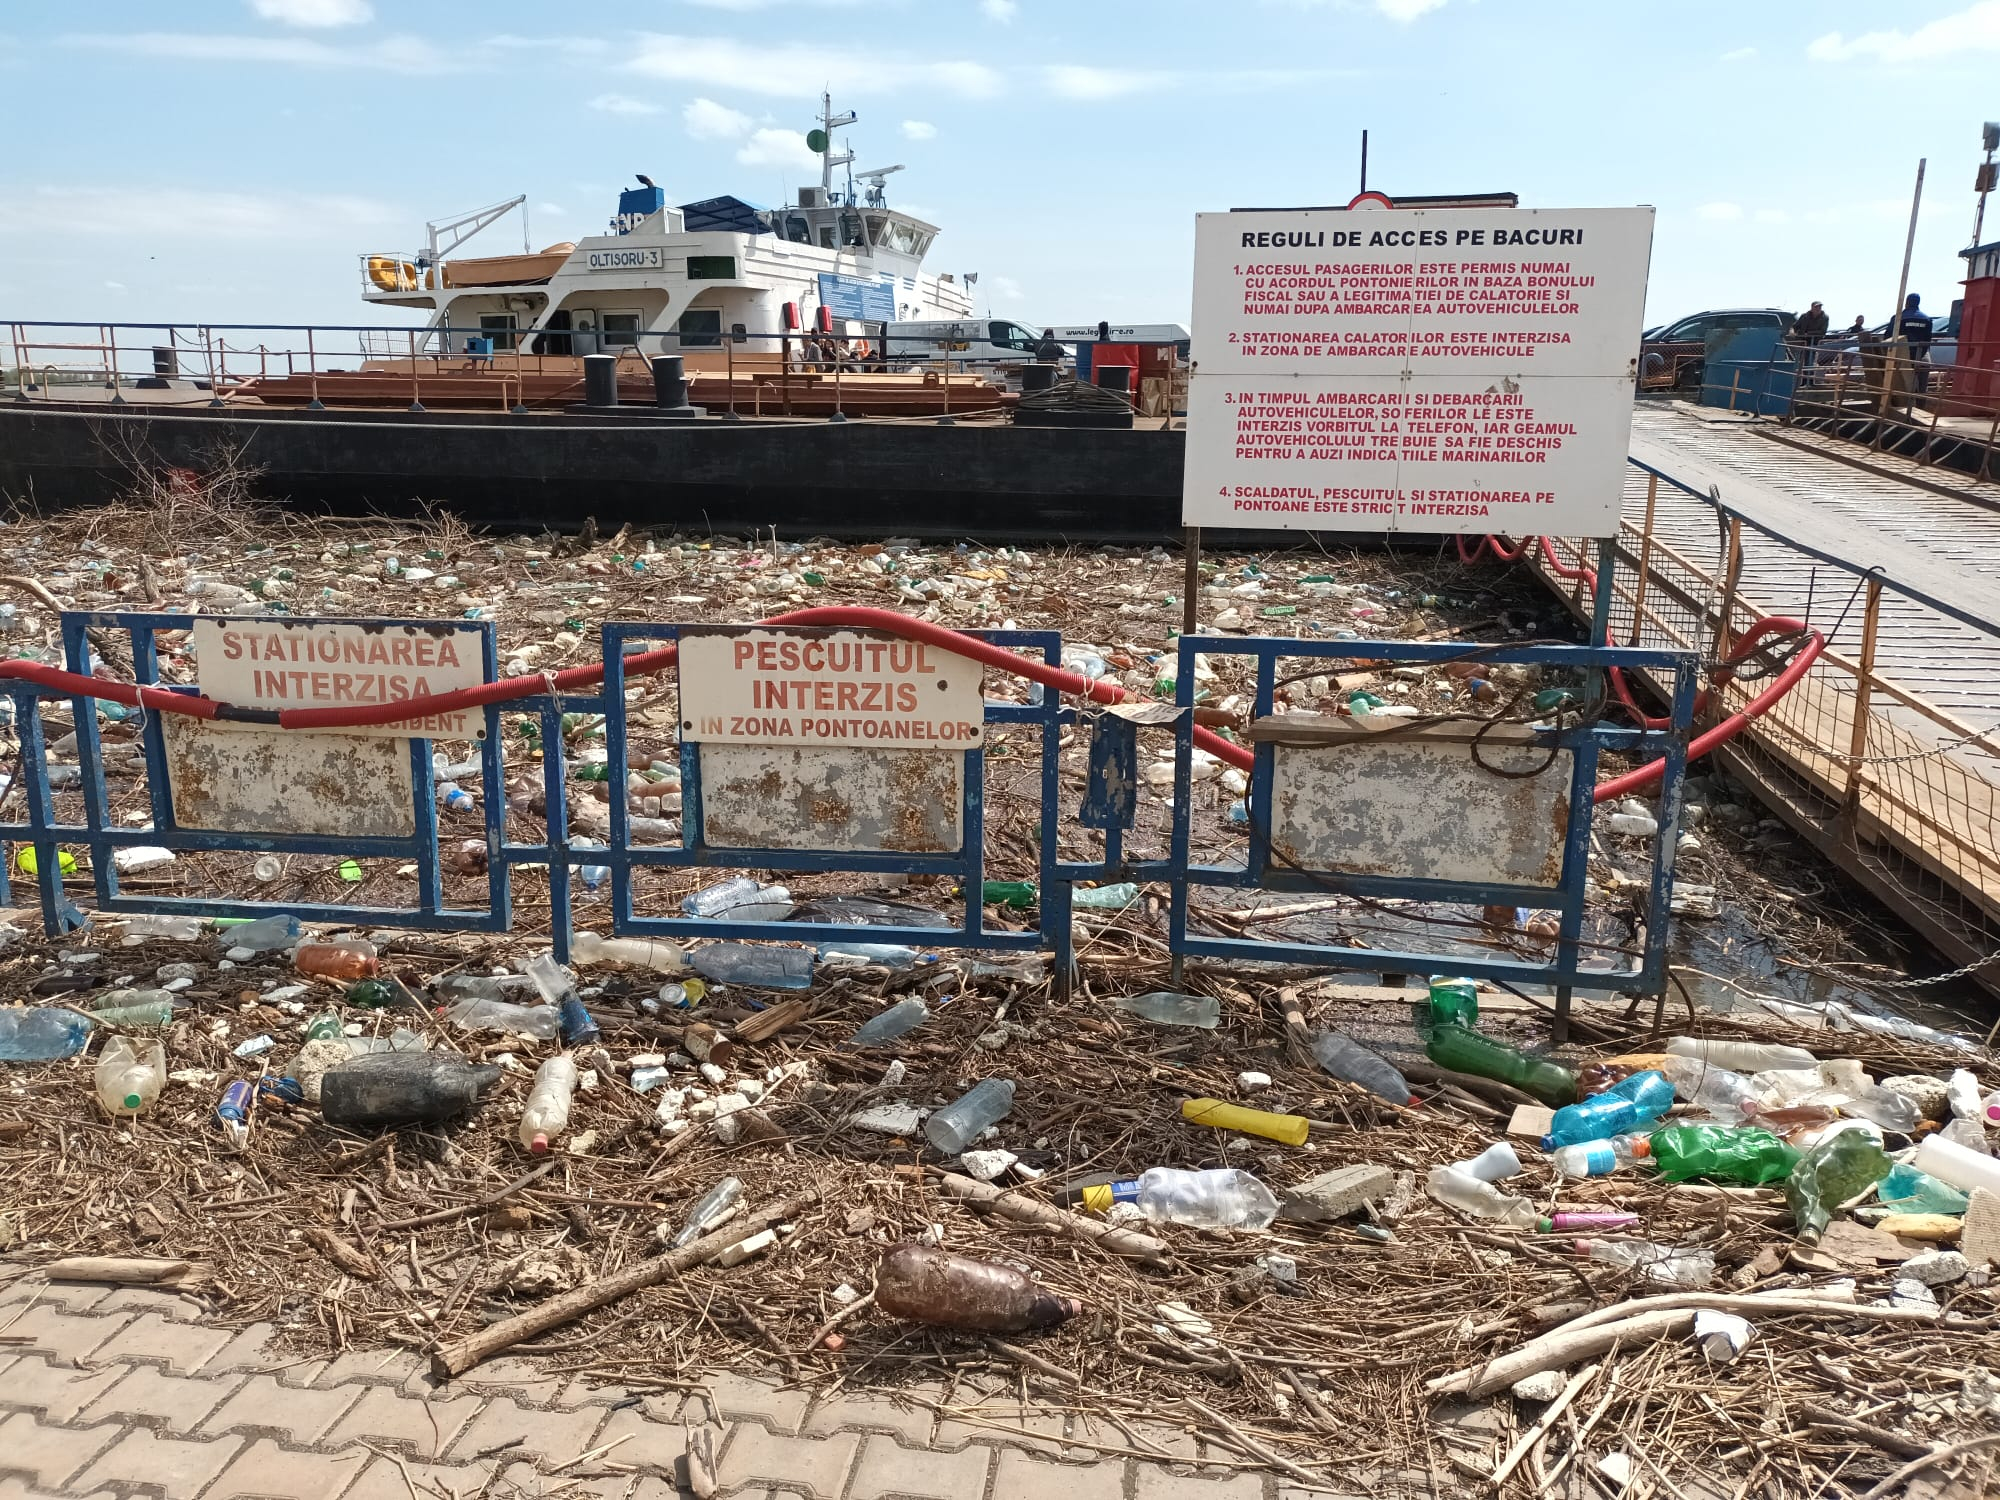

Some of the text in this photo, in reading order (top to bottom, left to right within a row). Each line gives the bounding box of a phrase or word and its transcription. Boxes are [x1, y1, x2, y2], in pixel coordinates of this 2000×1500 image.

[1241, 229, 1584, 247] REGULI DE ACCES PE BACURI
[590, 252, 658, 267] OLTISORU-3
[1233, 263, 1571, 275] 1. ACCESUL PASAGERILOR ESTE PERMIS NUMAI
[1245, 278, 1264, 288] CU
[1268, 277, 1335, 288] ACORDUL
[1463, 277, 1479, 287] IN
[1483, 277, 1523, 287] BAZA
[1526, 276, 1595, 287] BONULUI
[1244, 291, 1293, 301] FISCAL
[1297, 291, 1327, 301] SAU
[1330, 290, 1340, 300] A
[1445, 290, 1466, 300] DE
[1469, 290, 1551, 300] CALATORIE
[1555, 290, 1571, 300] SI
[1243, 304, 1290, 314] NUMAI
[1293, 304, 1331, 314] DUPA
[1436, 303, 1580, 314] AUTOVEHICULELOR
[1228, 333, 1571, 343] 2. STATIONAREA CALATORILOR ESTE INTERZISA
[1242, 345, 1535, 356] IN ZONA DE AMBARCARE AUTOVEHICULE
[1225, 393, 1523, 406] 3. IN TIMPUL AMBARCARII SI DEBARCARII
[1237, 406, 1378, 421] AUTOVEHICULELOR,
[1472, 409, 1492, 419] LE
[1496, 408, 1534, 420] ESTE
[1236, 420, 1578, 435] INTERZIS VORBITUL LA TELEFON, IAR GEAMUL
[1236, 434, 1367, 446] AUTOVEHICOLULUI
[1444, 436, 1465, 447] SA
[1469, 436, 1493, 448] FIE
[1496, 437, 1562, 448] DESCHIS
[1236, 448, 1293, 459] PENTRU
[1296, 448, 1306, 458] A
[1309, 448, 1345, 460] AUZI
[1442, 450, 1546, 462] MARINARILOR
[1219, 486, 1555, 503] 4. SCALDATUL, PESCUITUL SI STATIONAREA PE
[1234, 500, 1310, 512] PONTOANE
[1313, 501, 1348, 512] ESTE
[1410, 502, 1489, 515] INTERZISA
[223, 631, 460, 668] STATIONAREA
[734, 640, 936, 673] PESCUITUL
[253, 670, 431, 702] INTERZISA
[753, 680, 918, 712] INTERZIS
[701, 716, 972, 740] IN ZONA PONTOANELOR
